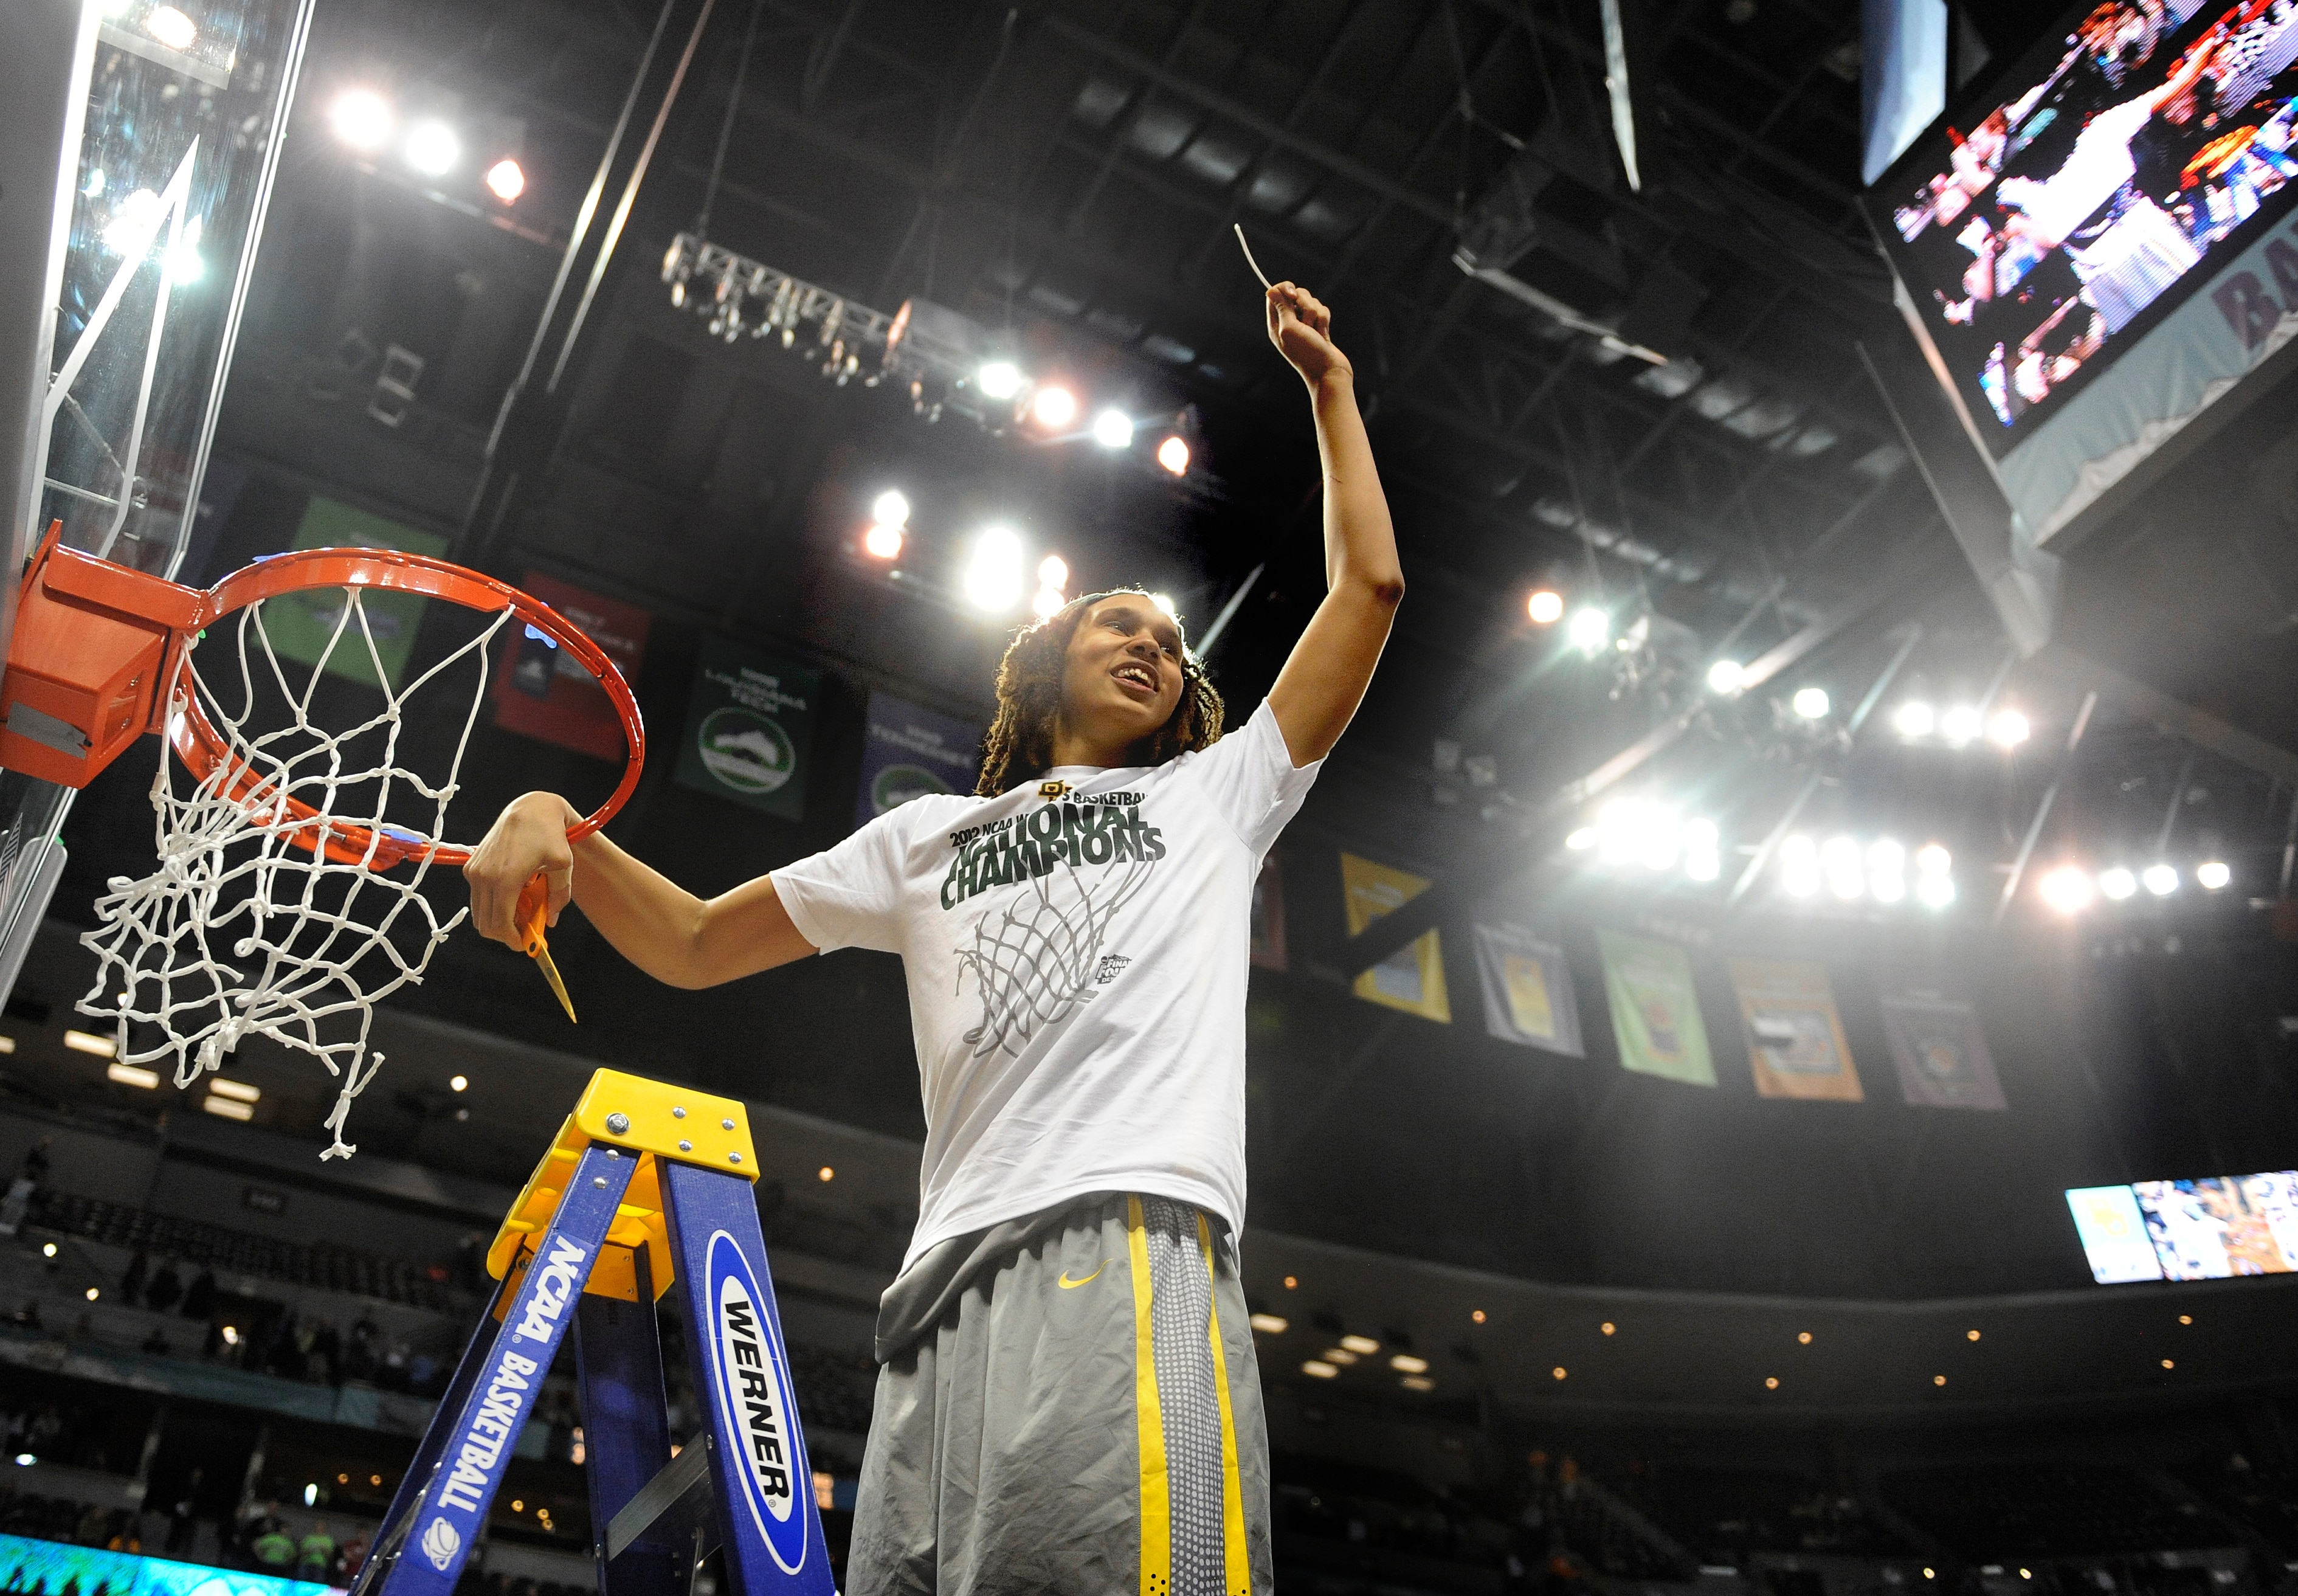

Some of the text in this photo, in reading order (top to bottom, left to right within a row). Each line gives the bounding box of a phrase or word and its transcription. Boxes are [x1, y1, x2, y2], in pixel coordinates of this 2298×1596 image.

[2211, 219, 2298, 351] BA
[950, 826, 980, 847] 2012
[982, 818, 1012, 836] NCAA
[1074, 791, 1148, 806] BASKETBA
[941, 827, 1167, 911] CHAMPIONS
[1096, 964, 1120, 978] FOU
[1106, 958, 1129, 967] FINA
[437, 1234, 587, 1513] NCAA BASKETBALL
[725, 1300, 790, 1498] WERNER
